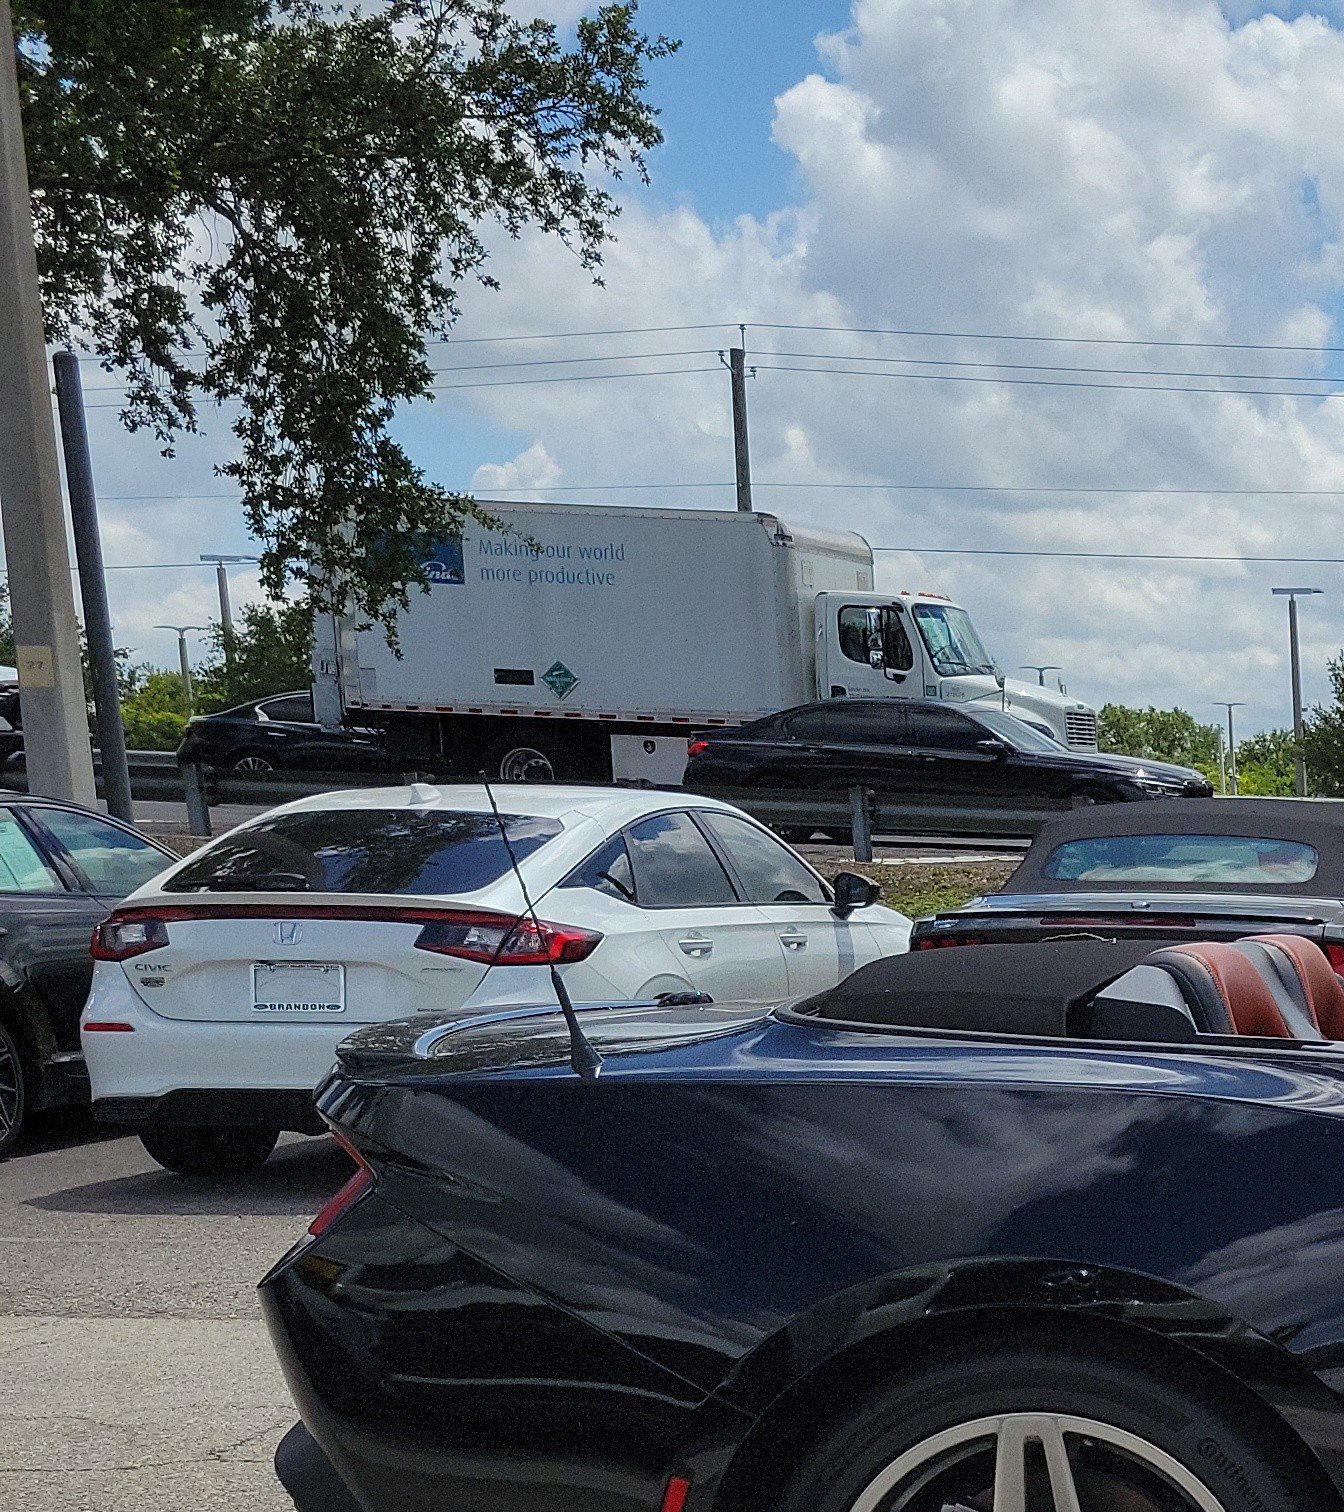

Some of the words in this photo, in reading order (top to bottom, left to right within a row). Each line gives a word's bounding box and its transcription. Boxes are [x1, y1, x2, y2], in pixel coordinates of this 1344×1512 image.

[479, 538, 540, 562] Making
[546, 544, 572, 559] our
[578, 543, 625, 561] world
[480, 567, 522, 582] more
[528, 566, 615, 586] productive
[135, 963, 173, 972] CIVIC
[269, 1003, 325, 1011] BRANDON
